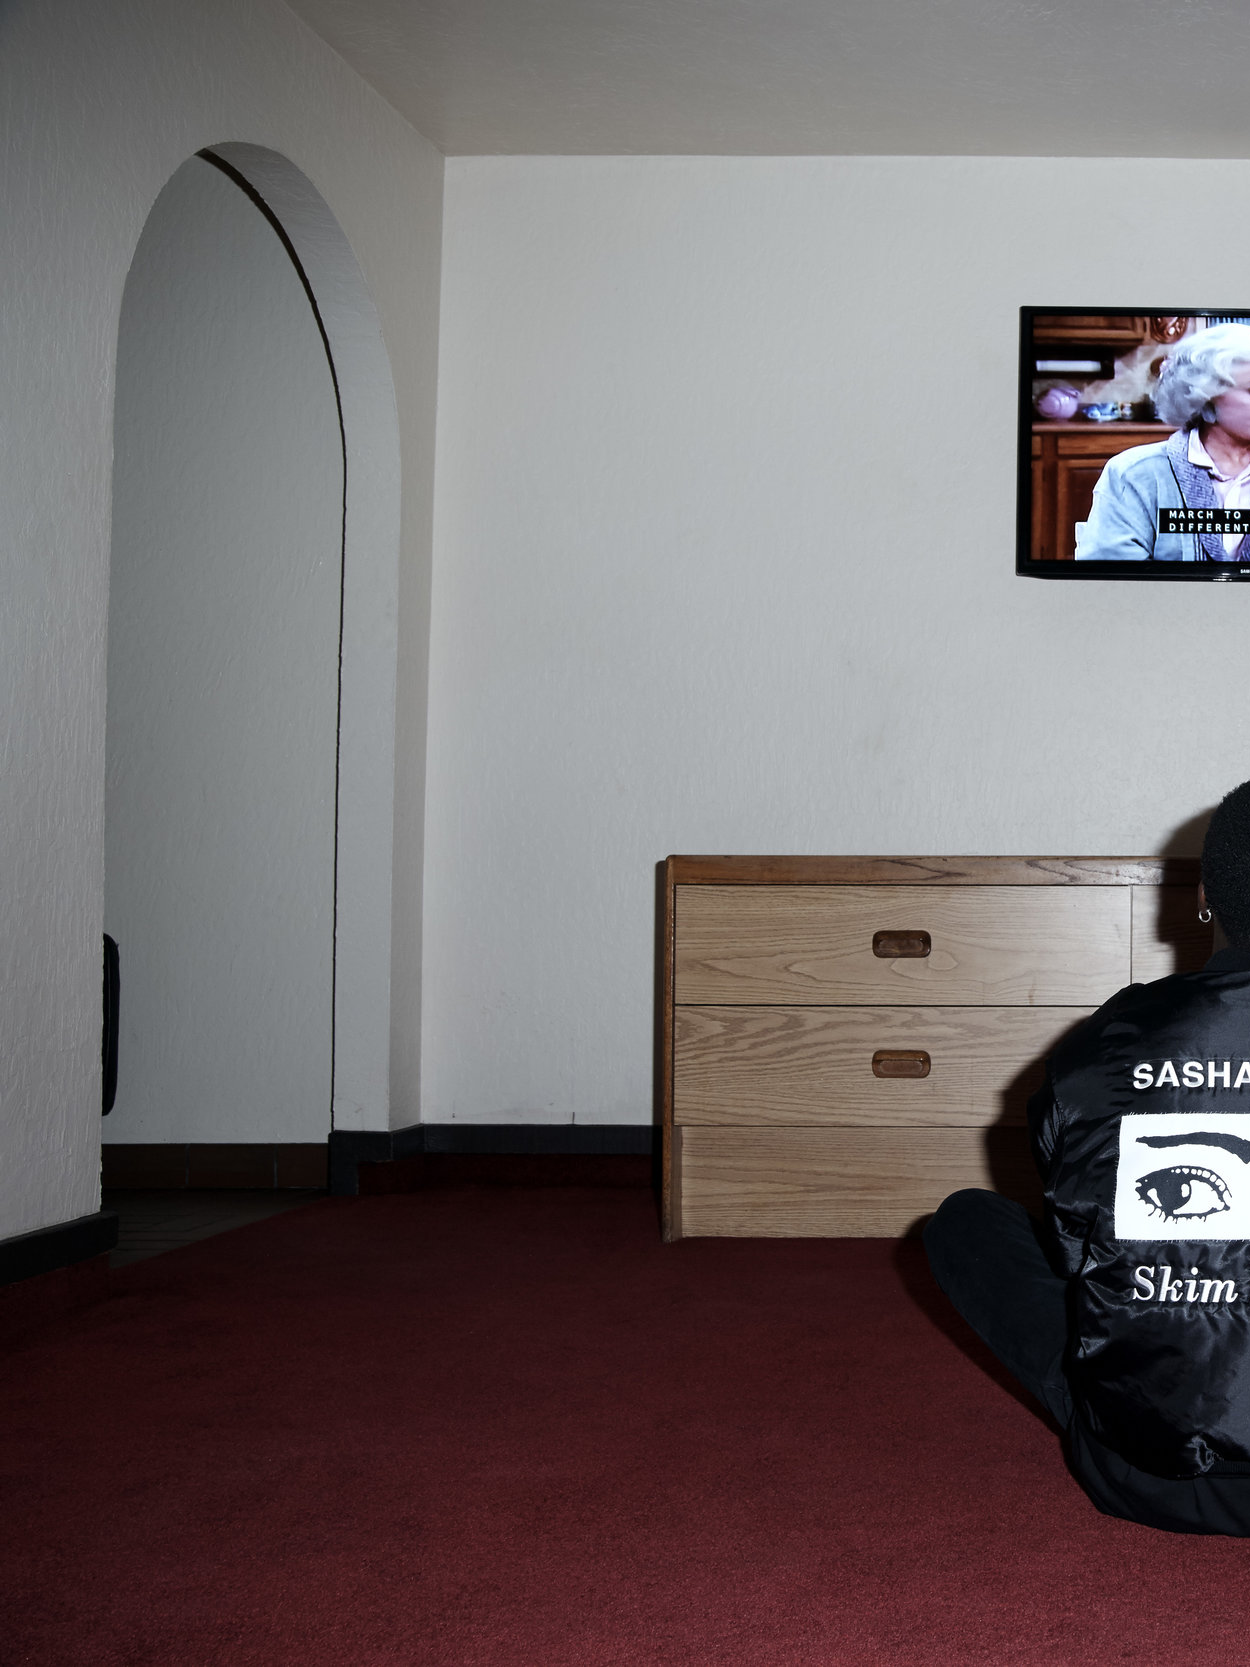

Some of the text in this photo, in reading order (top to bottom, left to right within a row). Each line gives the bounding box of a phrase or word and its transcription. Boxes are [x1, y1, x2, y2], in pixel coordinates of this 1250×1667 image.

[1168, 510, 1214, 520] MARCH
[1224, 510, 1242, 520] TO
[1168, 523, 1250, 532] DIFFERENT
[1132, 1264, 1239, 1303] Skim
